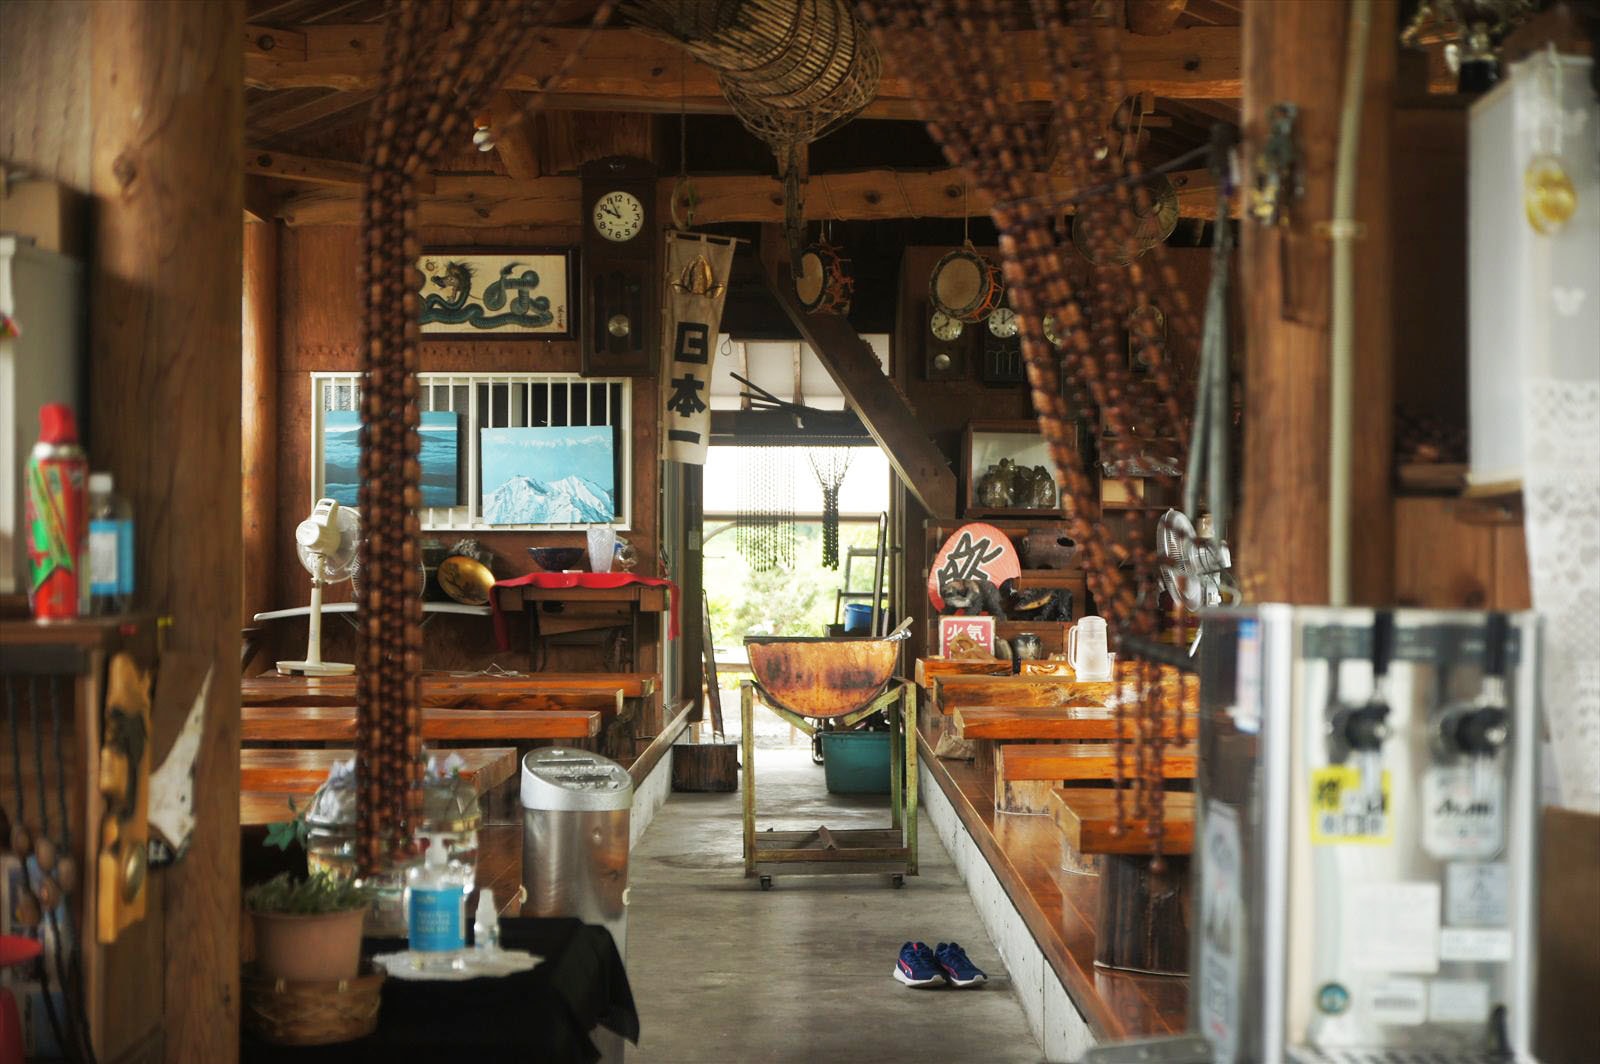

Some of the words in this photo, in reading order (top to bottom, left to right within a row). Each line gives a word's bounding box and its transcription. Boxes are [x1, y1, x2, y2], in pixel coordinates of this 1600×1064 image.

[667, 321, 709, 444] 日本一
[946, 624, 985, 641] 火気
